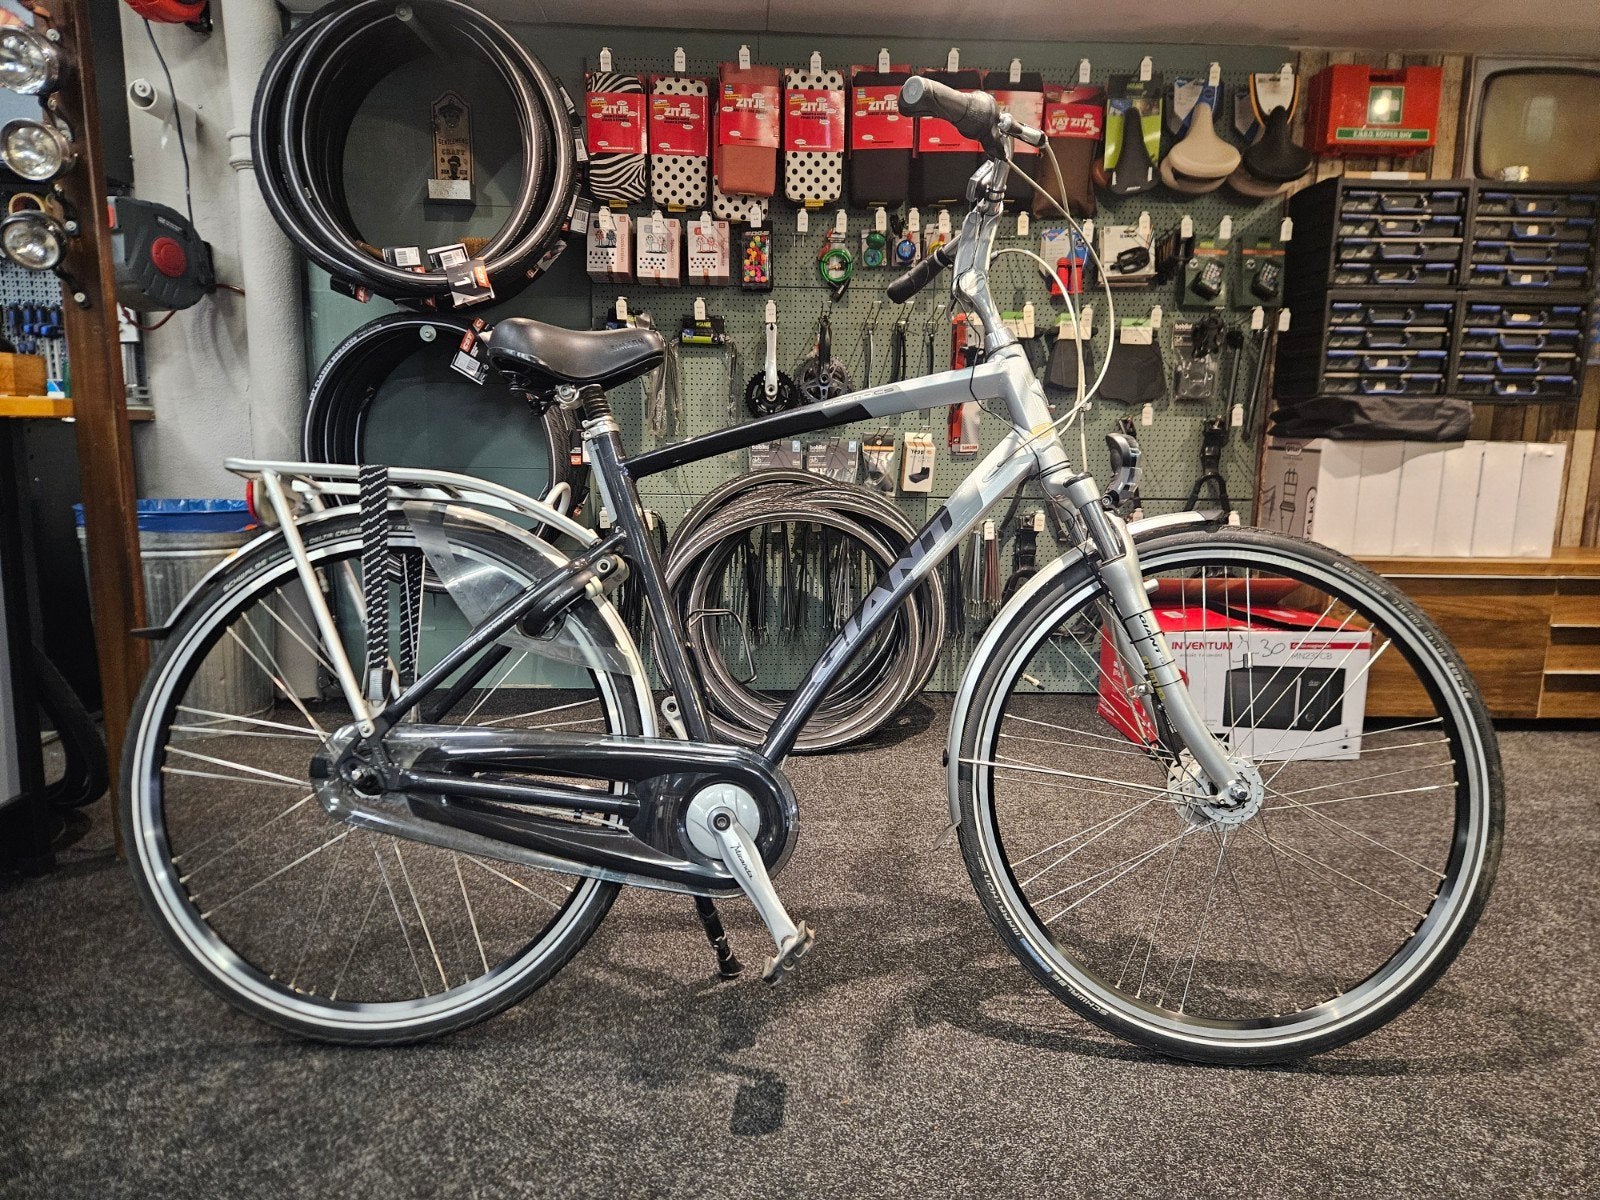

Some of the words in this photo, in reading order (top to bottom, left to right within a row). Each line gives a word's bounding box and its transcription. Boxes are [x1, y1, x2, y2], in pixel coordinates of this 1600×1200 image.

[736, 98, 765, 109] ZITJE
[800, 102, 828, 112] ZITJE
[868, 100, 899, 111] ZITJE
[601, 105, 629, 115] ZITJE
[664, 107, 692, 117] ZITJE
[1070, 118, 1095, 127] ZITJE
[308, 532, 334, 545] DELTA
[222, 559, 267, 592] SCHWALBE
[812, 507, 949, 684] GIANT
[1139, 614, 1160, 653] GIANT
[1171, 641, 1233, 650] INVENTUM
[731, 844, 753, 881] Miranda
[1052, 974, 1110, 1016] SCHWALBE
